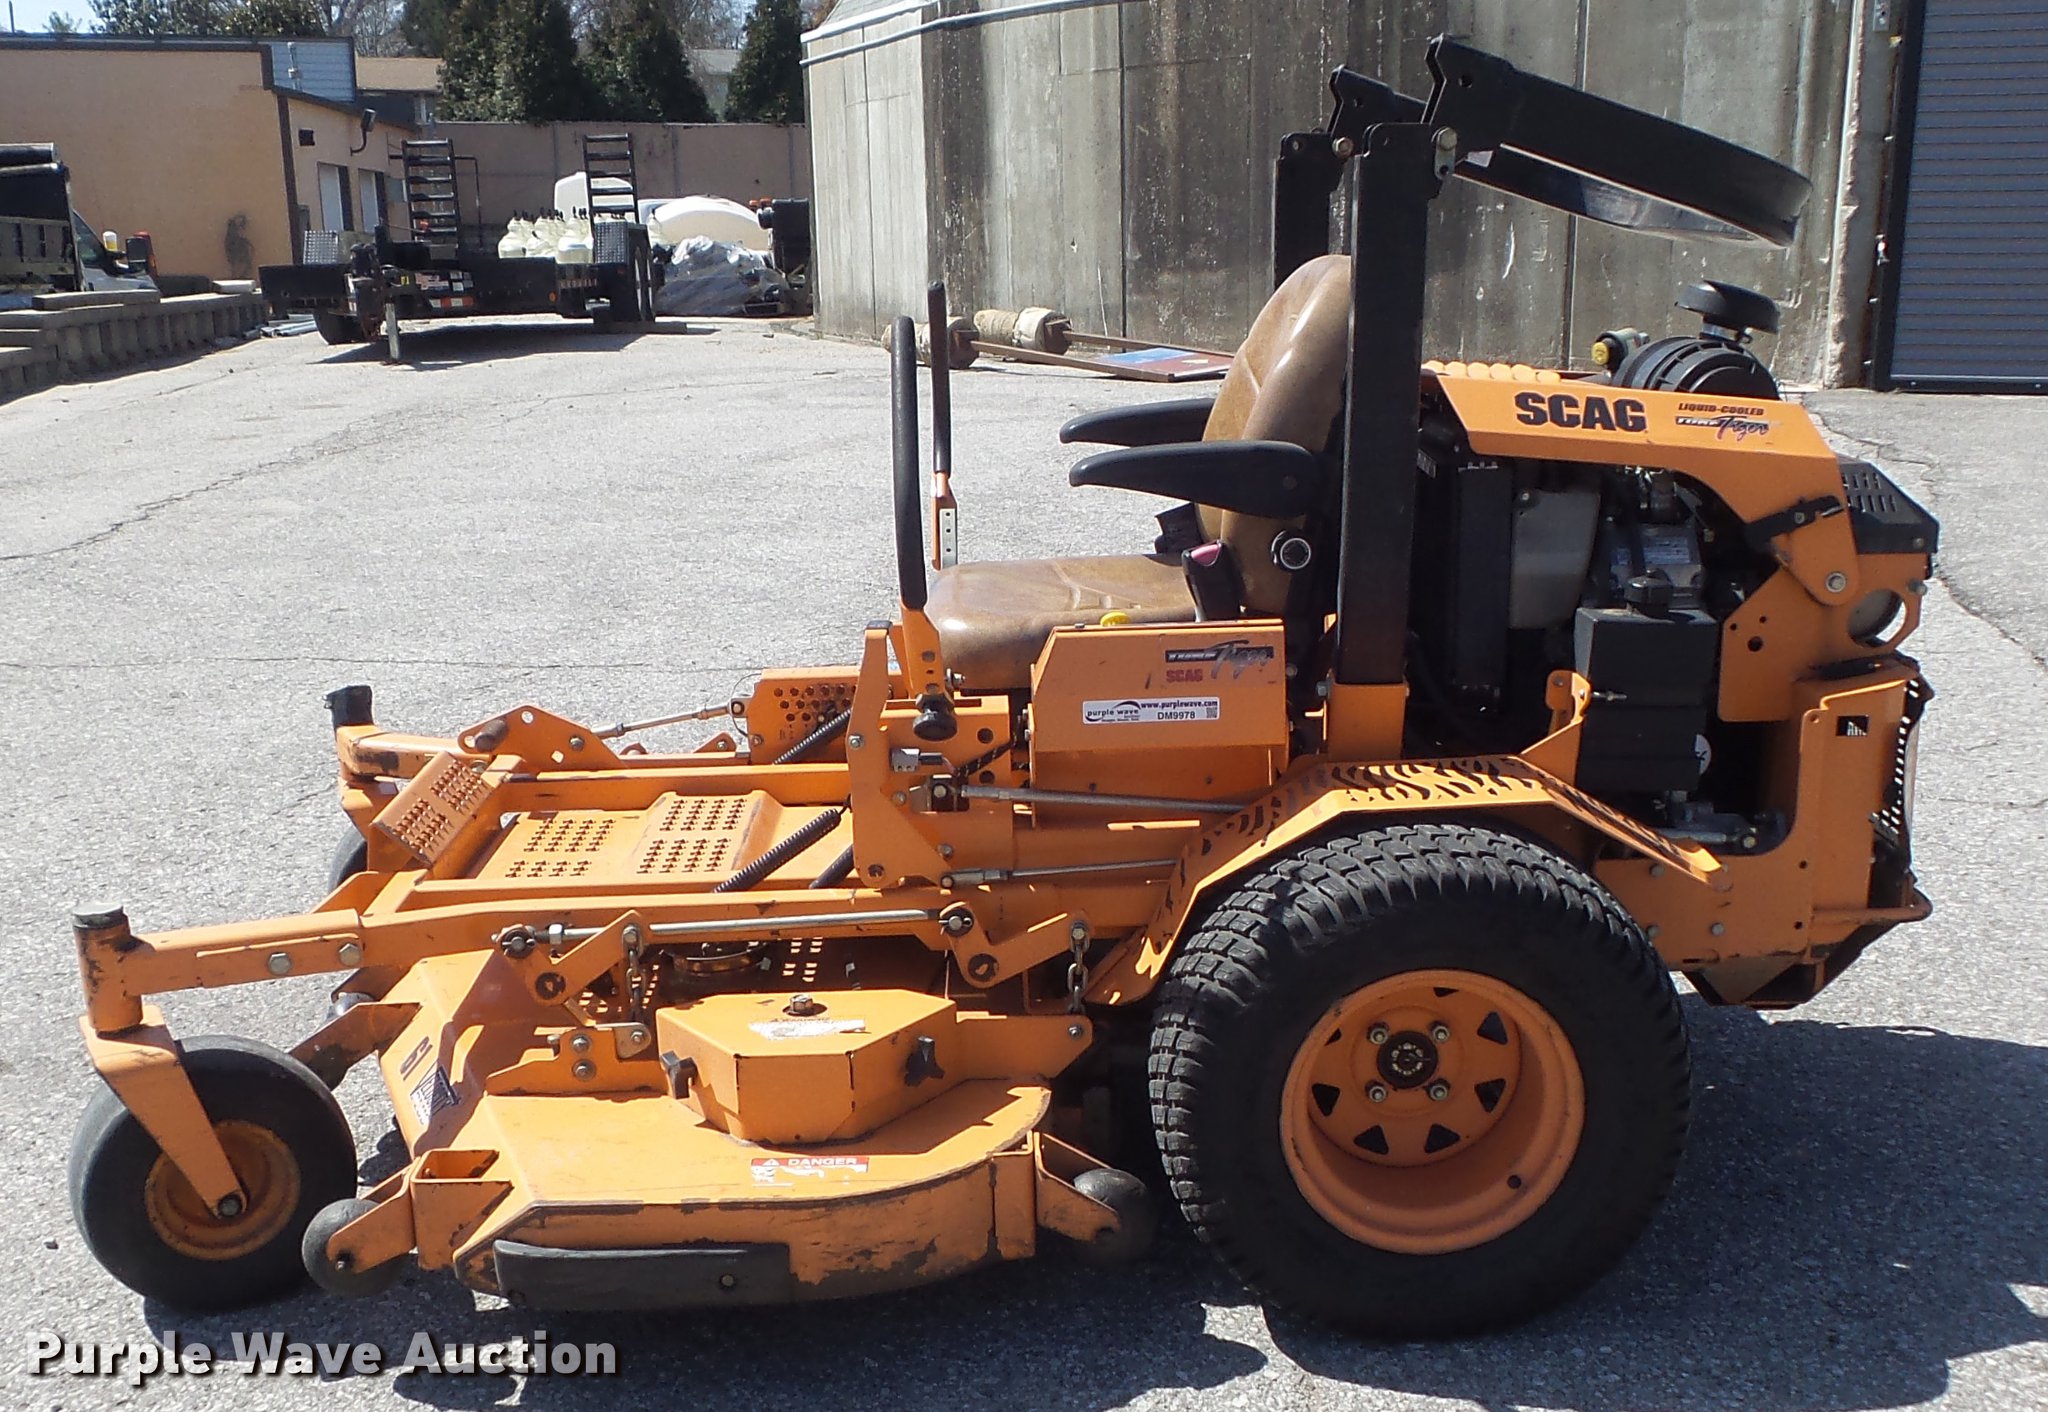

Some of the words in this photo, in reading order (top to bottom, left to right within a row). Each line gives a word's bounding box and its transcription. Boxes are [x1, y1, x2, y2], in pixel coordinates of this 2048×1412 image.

[1514, 391, 1647, 433] SCAG
[1678, 402, 1764, 416] LIQUID-COOLED
[1141, 700, 1218, 709] www.purplewave.com
[1087, 708, 1115, 717] purple
[1157, 710, 1196, 720] DM9978
[787, 1157, 858, 1167] DANGER
